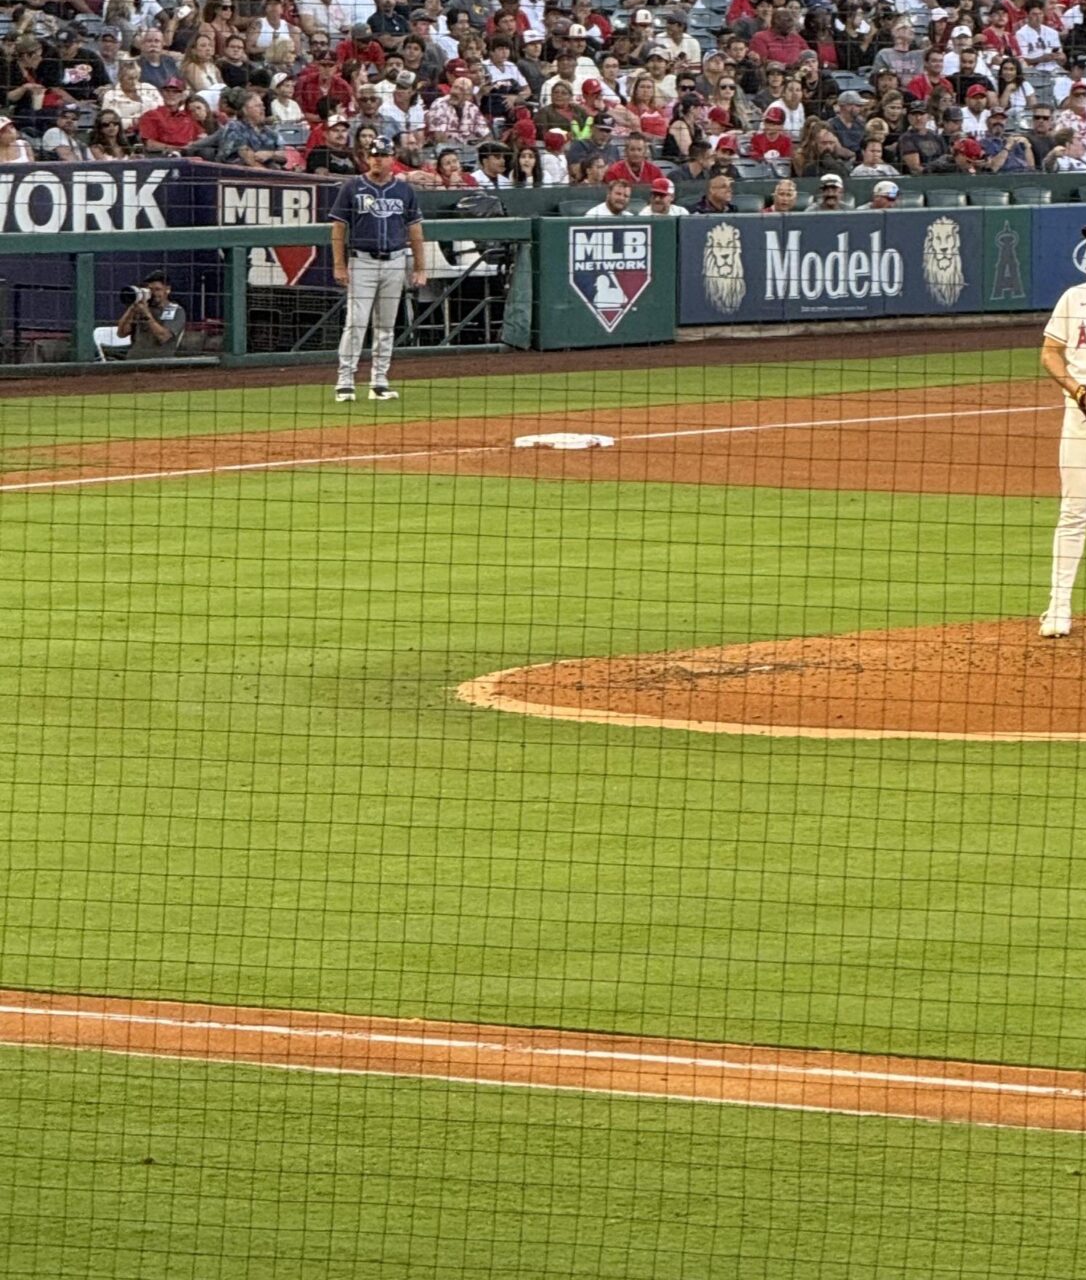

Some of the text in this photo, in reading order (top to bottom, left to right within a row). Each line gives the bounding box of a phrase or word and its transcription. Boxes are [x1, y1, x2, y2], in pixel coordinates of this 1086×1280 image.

[224, 186, 310, 225] MLB
[575, 231, 647, 261] MLB
[574, 261, 647, 271] NETWORK
[764, 229, 904, 300] Modelo
